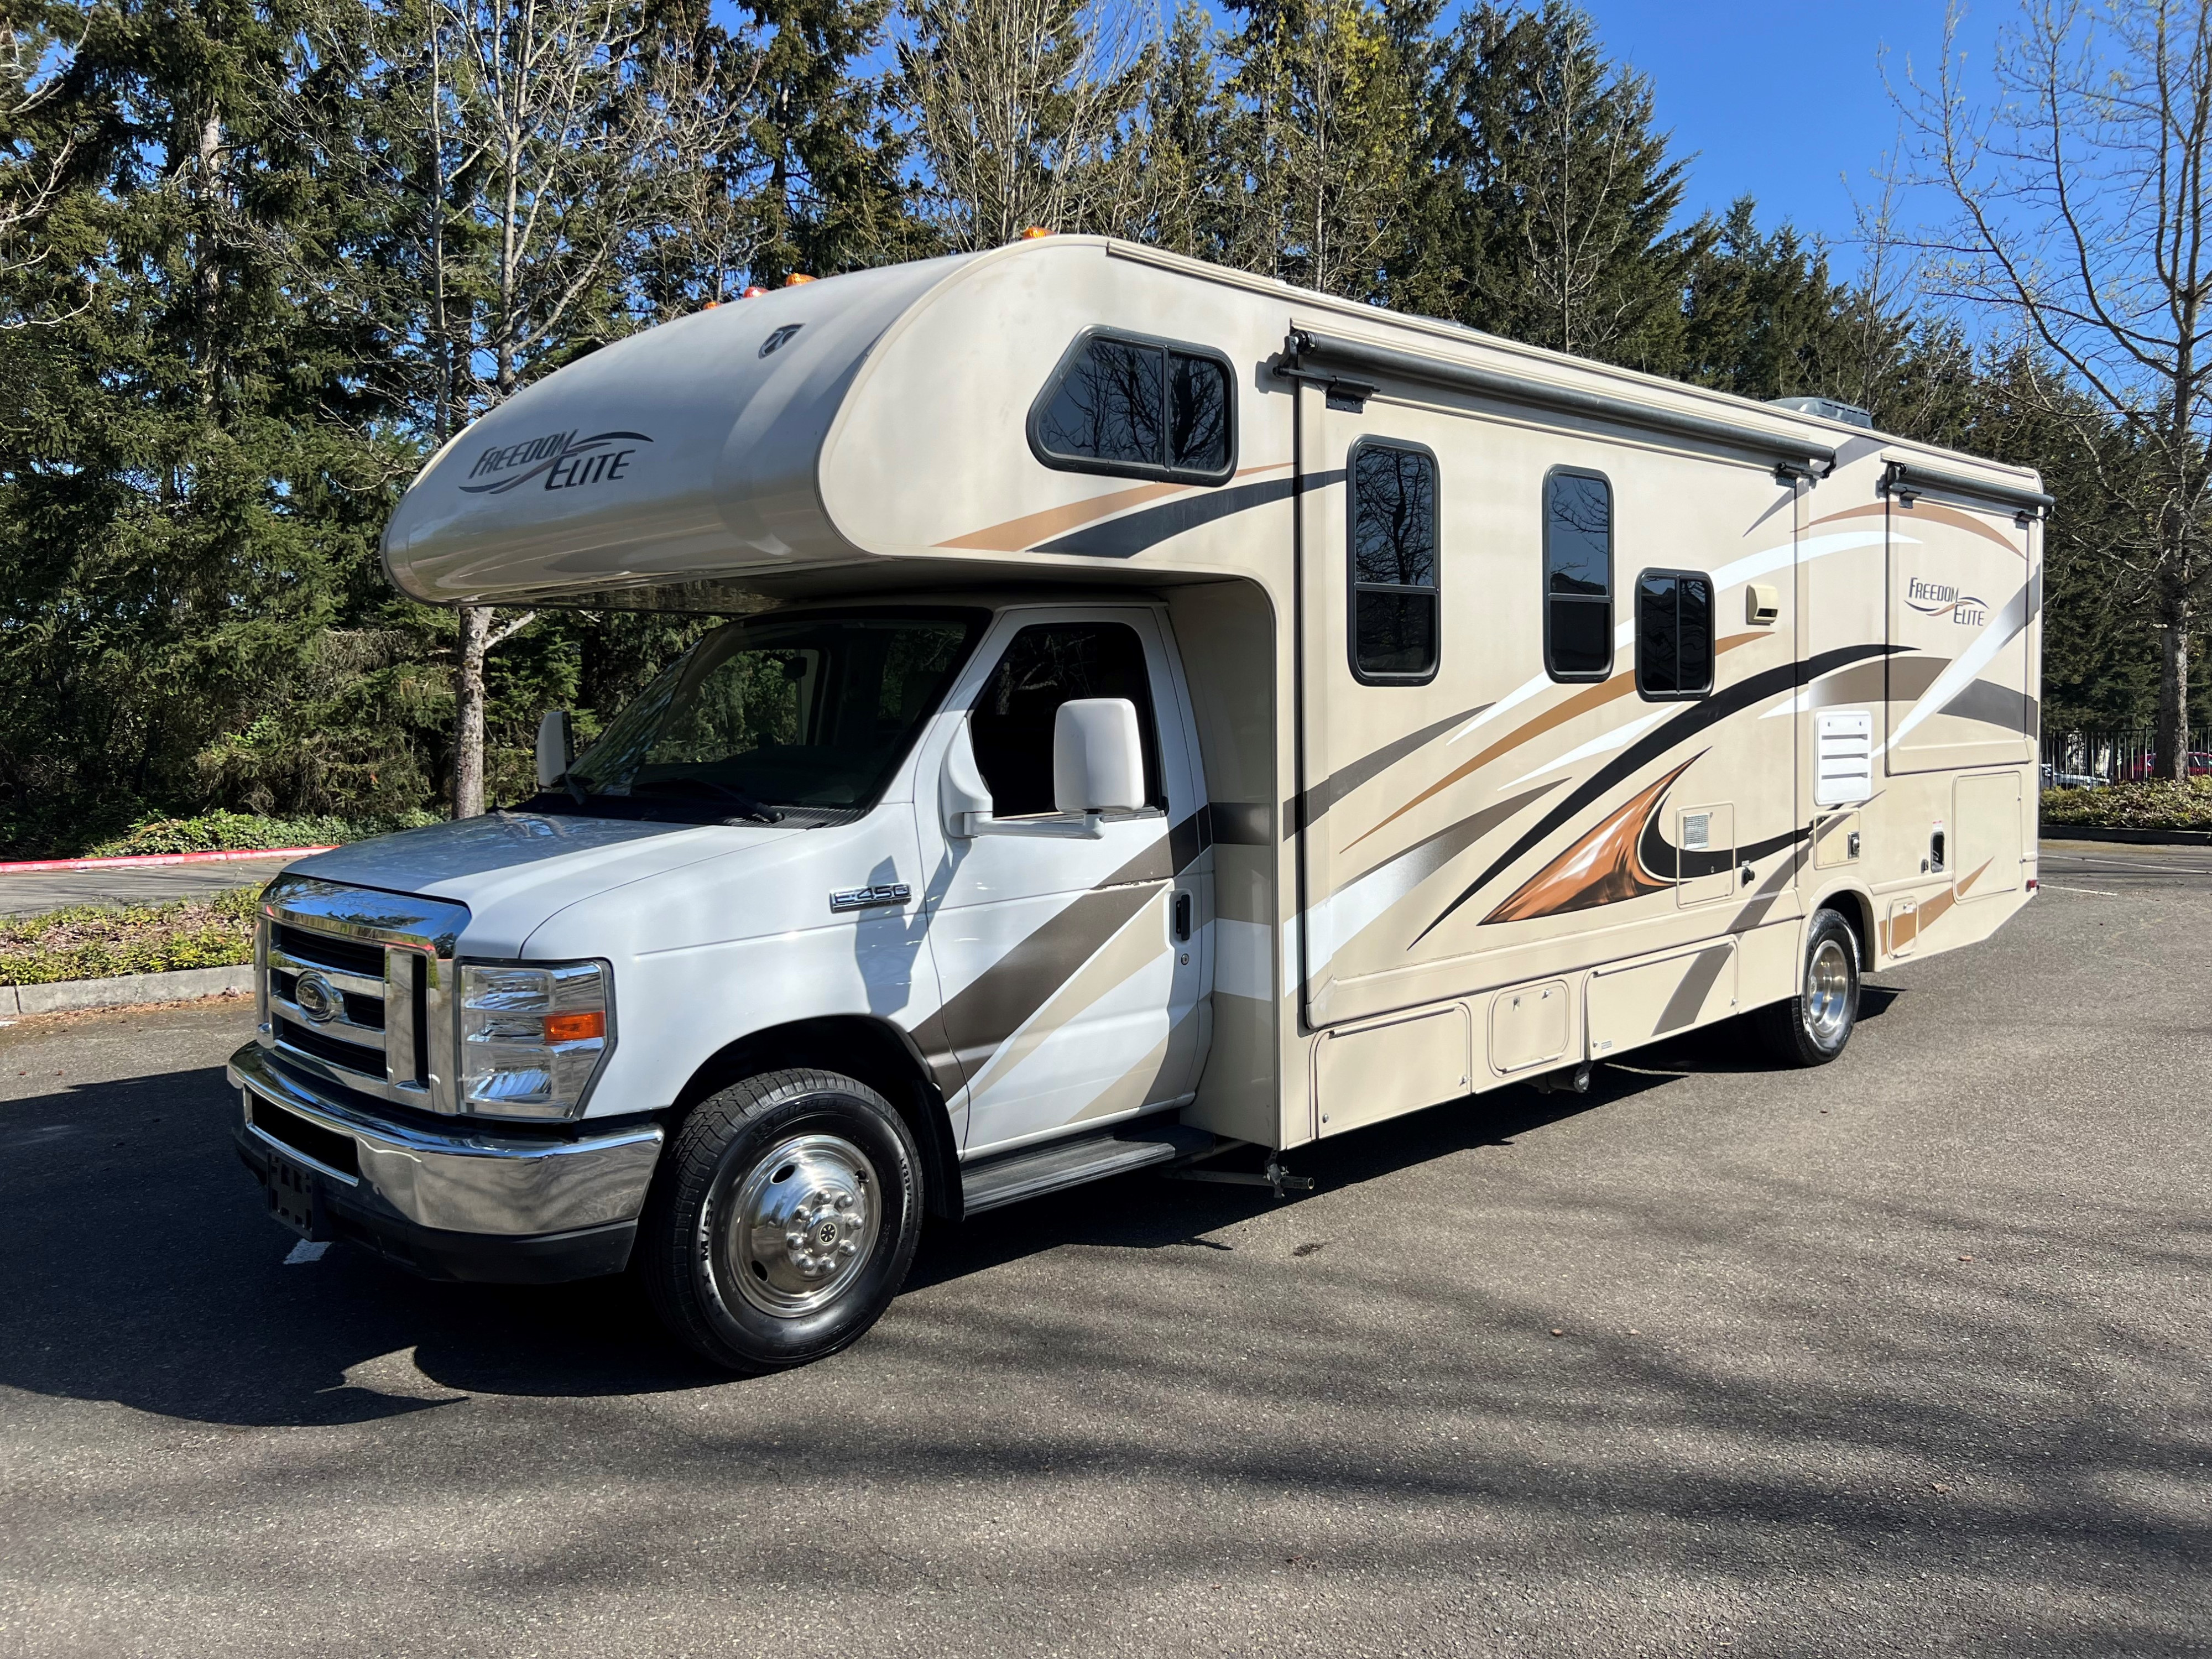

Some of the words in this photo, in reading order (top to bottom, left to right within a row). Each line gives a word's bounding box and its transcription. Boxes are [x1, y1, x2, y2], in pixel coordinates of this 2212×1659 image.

[468, 429, 580, 479] FREEDOM
[544, 449, 637, 492] ELITE
[1908, 577, 1959, 603] FREEDOM
[1953, 604, 1985, 626] ELITE
[834, 884, 910, 904] E-450
[298, 987, 319, 1007] Ford
